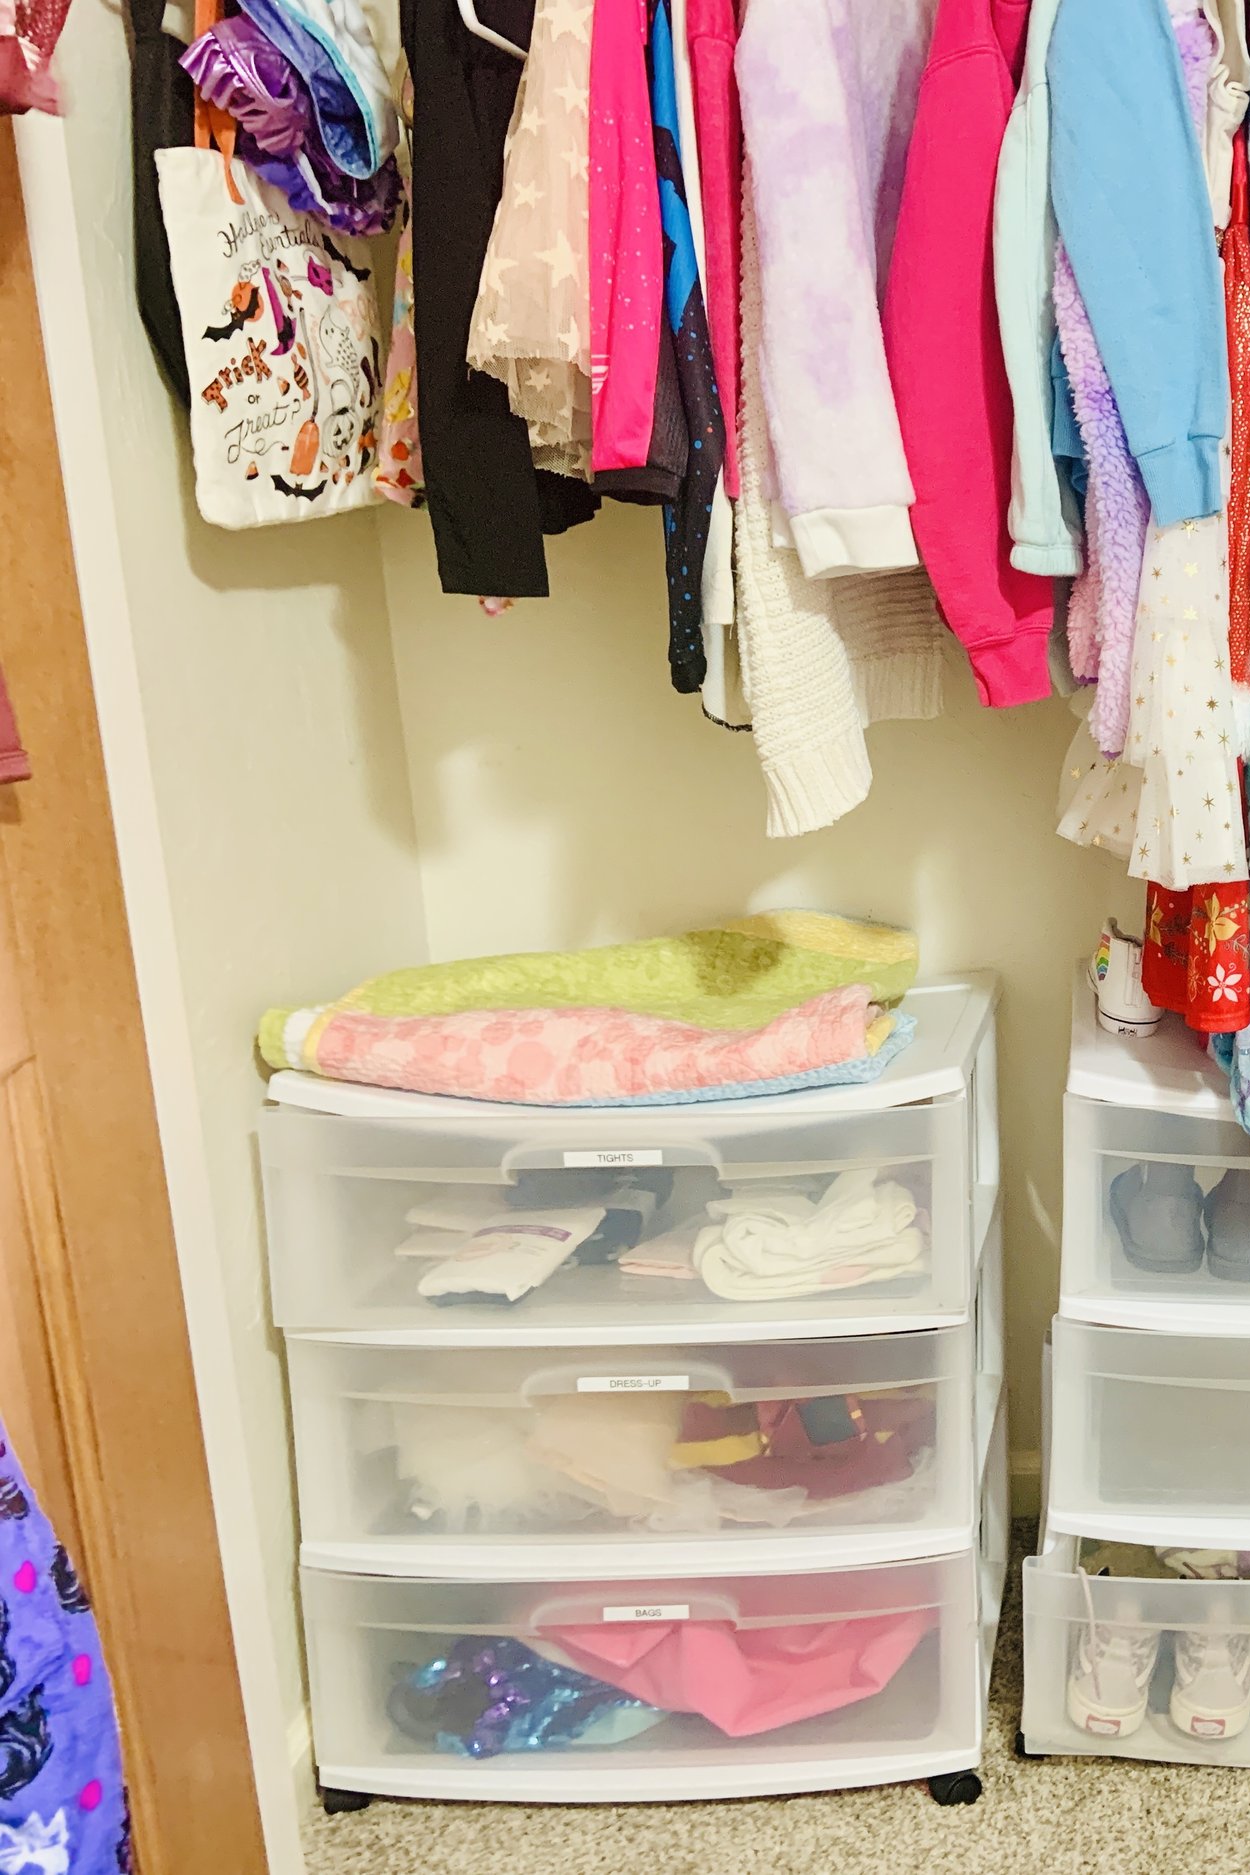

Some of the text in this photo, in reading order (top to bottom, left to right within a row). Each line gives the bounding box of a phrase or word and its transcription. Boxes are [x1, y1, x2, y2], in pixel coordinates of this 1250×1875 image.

[201, 337, 273, 414] Trick
[247, 394, 260, 405] or
[597, 1153, 634, 1163] TIGHTS
[609, 1379, 662, 1389] DRESS-UP
[635, 1608, 662, 1618] BAGS
